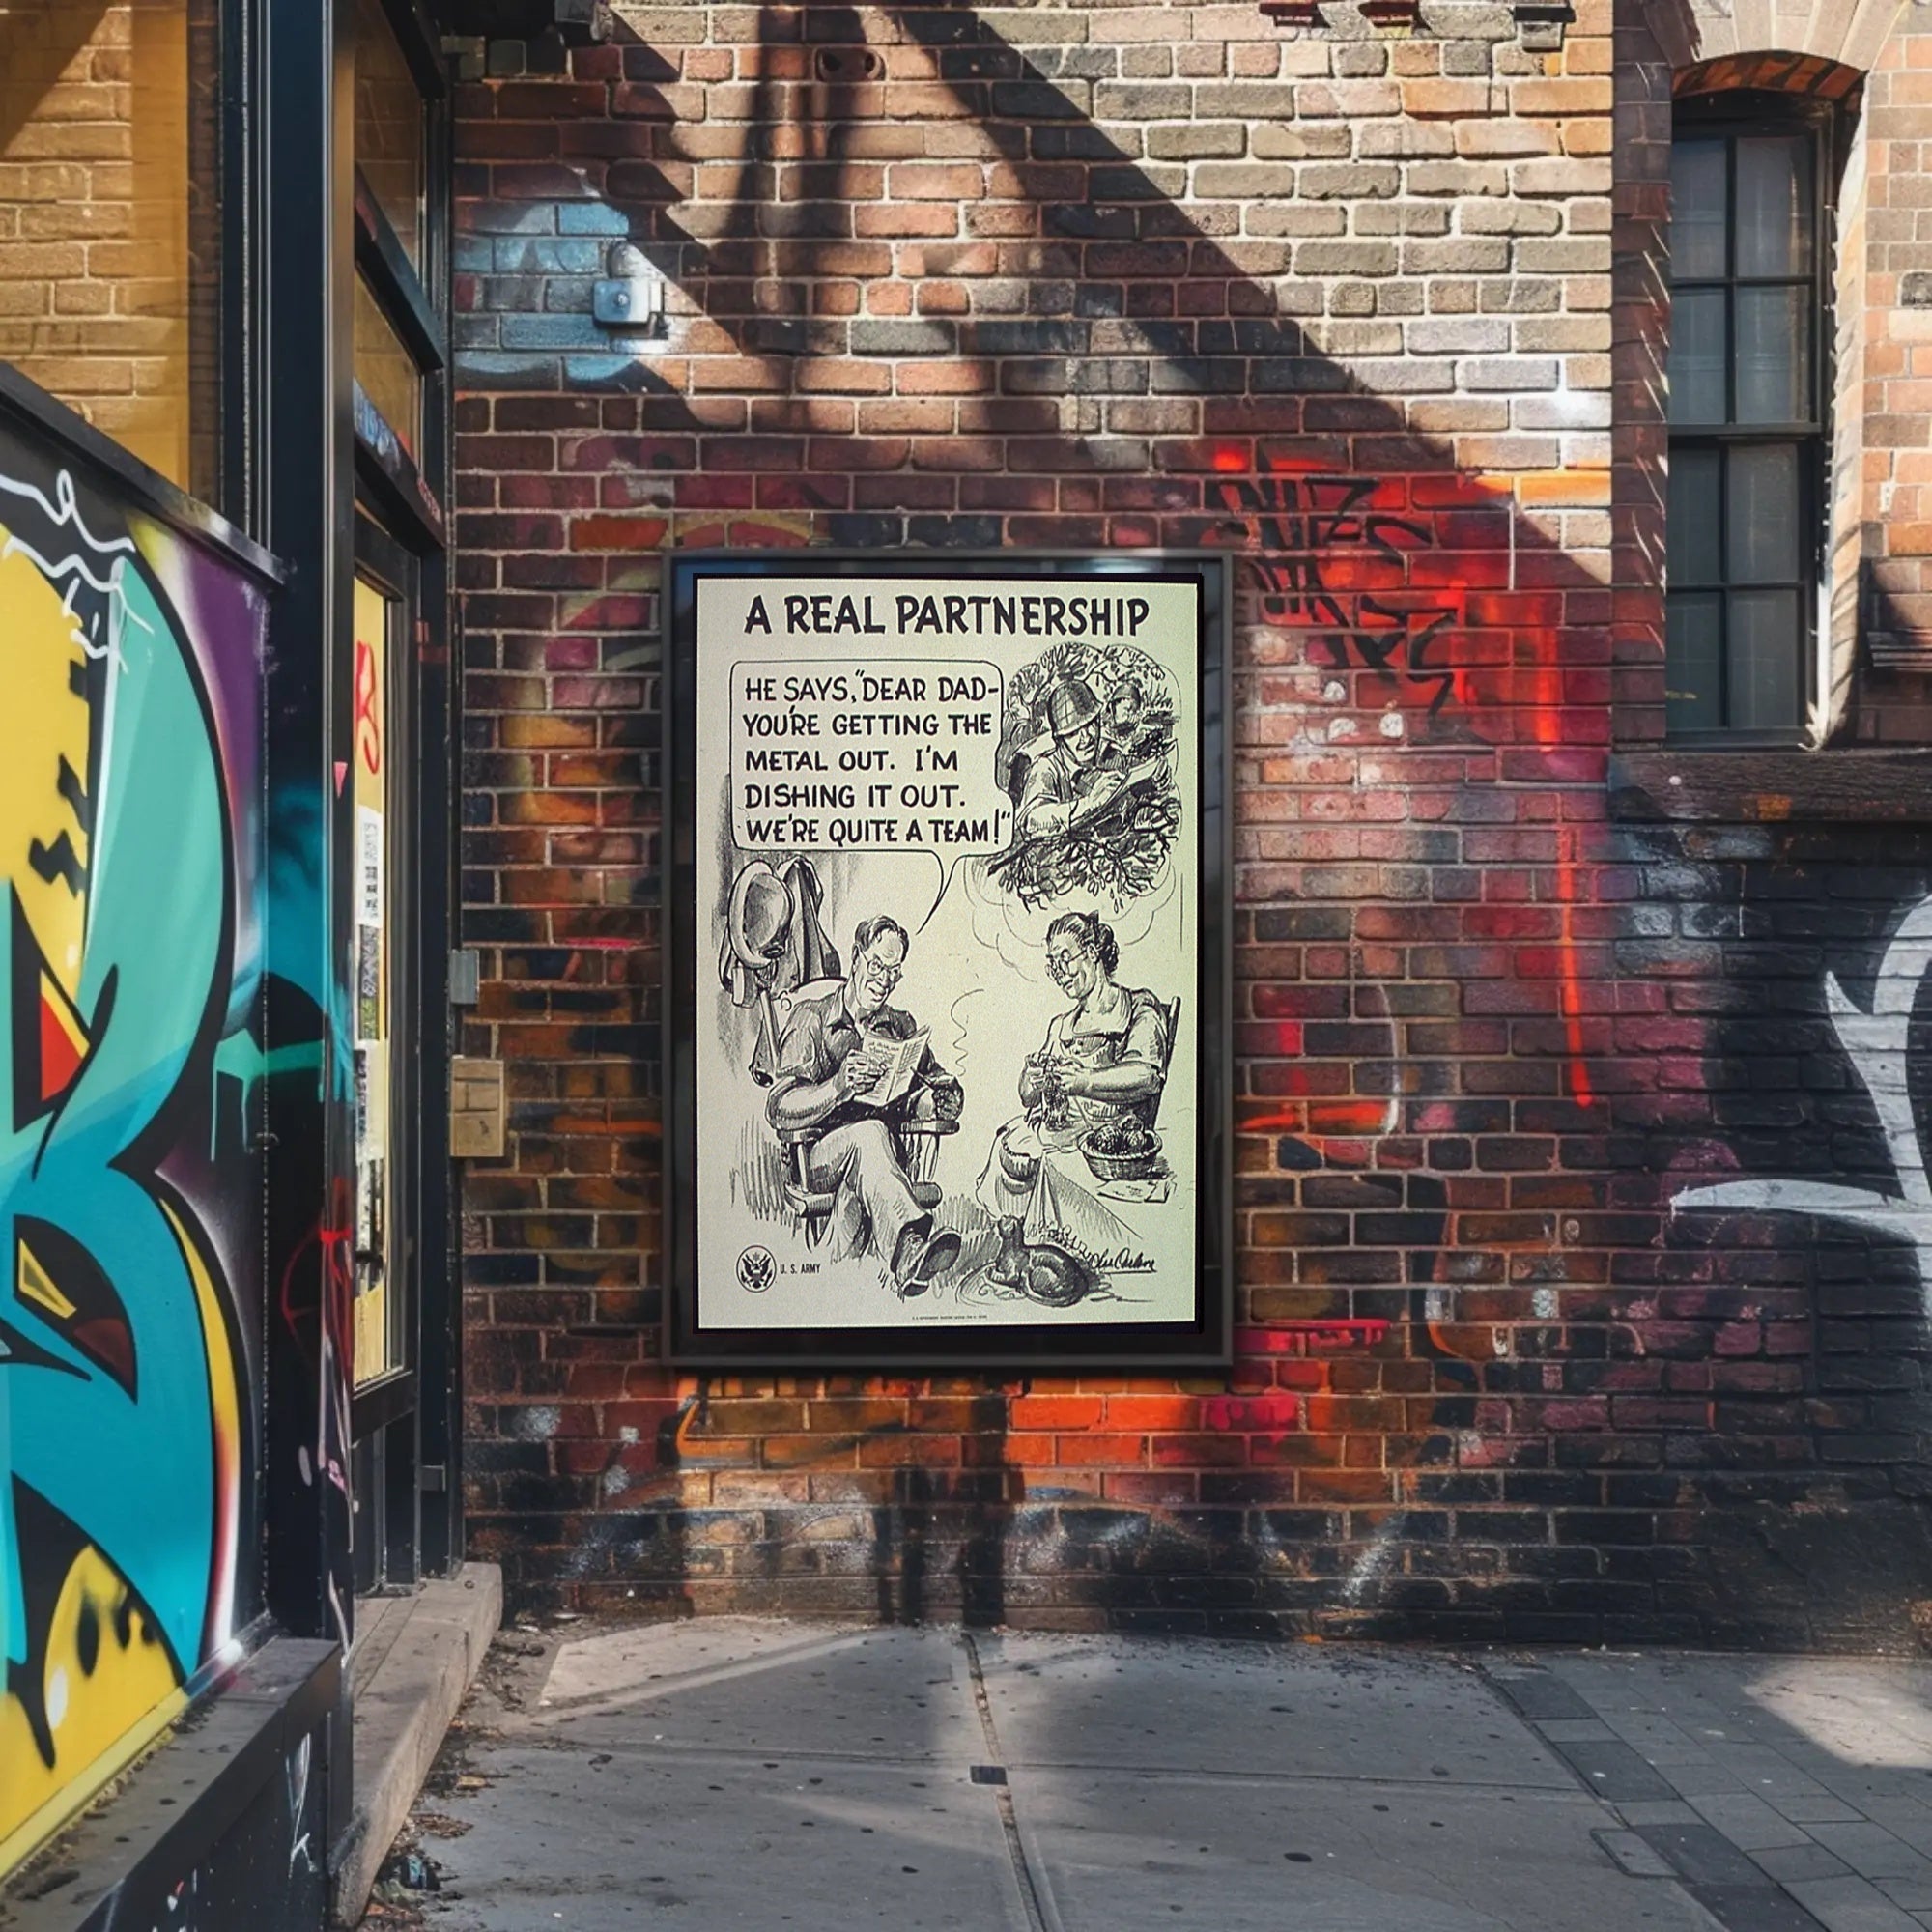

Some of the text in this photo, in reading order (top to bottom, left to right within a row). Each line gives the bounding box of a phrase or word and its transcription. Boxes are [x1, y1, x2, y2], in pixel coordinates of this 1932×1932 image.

[745, 595, 1150, 637] A REAL PARTNERSHIP
[745, 677, 777, 701] HE
[742, 705, 992, 737] YOU'RE GETTING THE
[745, 744, 958, 772] METAL OUT. I'M
[744, 784, 966, 809] DISHING IT OUT.
[746, 814, 819, 843] WE'RE
[828, 819, 898, 848] QUITE
[905, 819, 923, 842] A
[801, 1263, 821, 1274] ARMY
